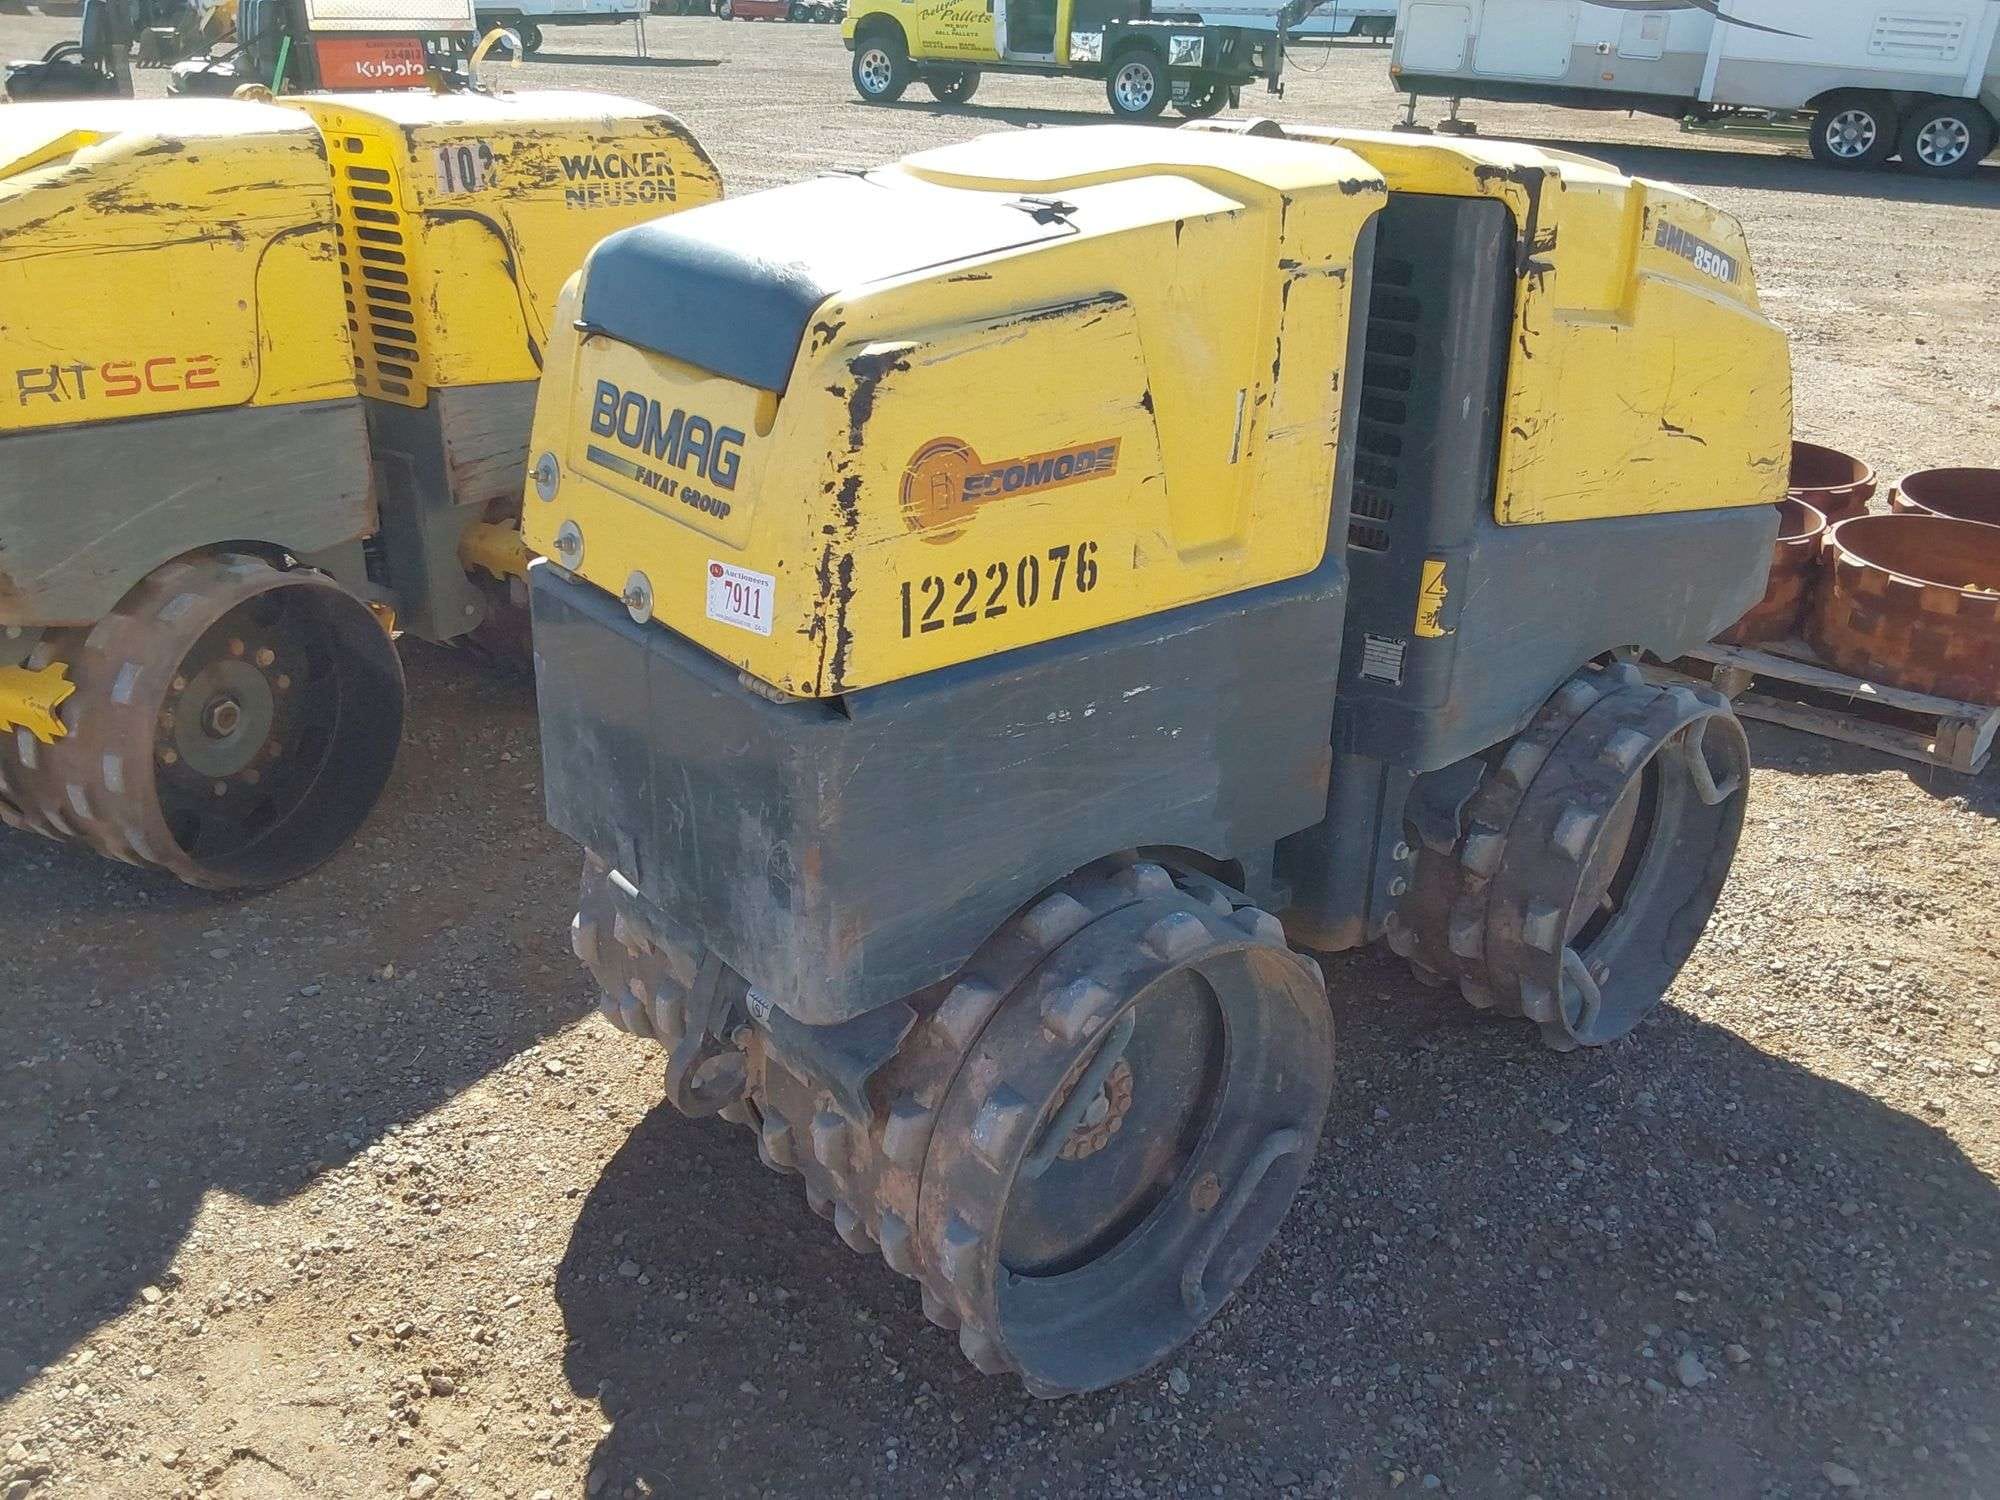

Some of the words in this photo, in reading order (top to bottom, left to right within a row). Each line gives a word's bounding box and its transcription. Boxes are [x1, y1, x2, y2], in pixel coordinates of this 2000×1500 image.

[940, 10, 992, 23] Pallets
[356, 60, 425, 77] Kubota
[565, 178, 677, 210] NEUSON
[1694, 245, 1729, 283] 8500
[591, 379, 746, 491] BOMAG
[962, 445, 1115, 502] ECOMODE
[635, 466, 678, 497] FAYAT
[680, 486, 731, 520] GROUP
[725, 568, 769, 586] Auctioneers
[902, 540, 1098, 638] 1222076
[724, 580, 760, 619] 7911
